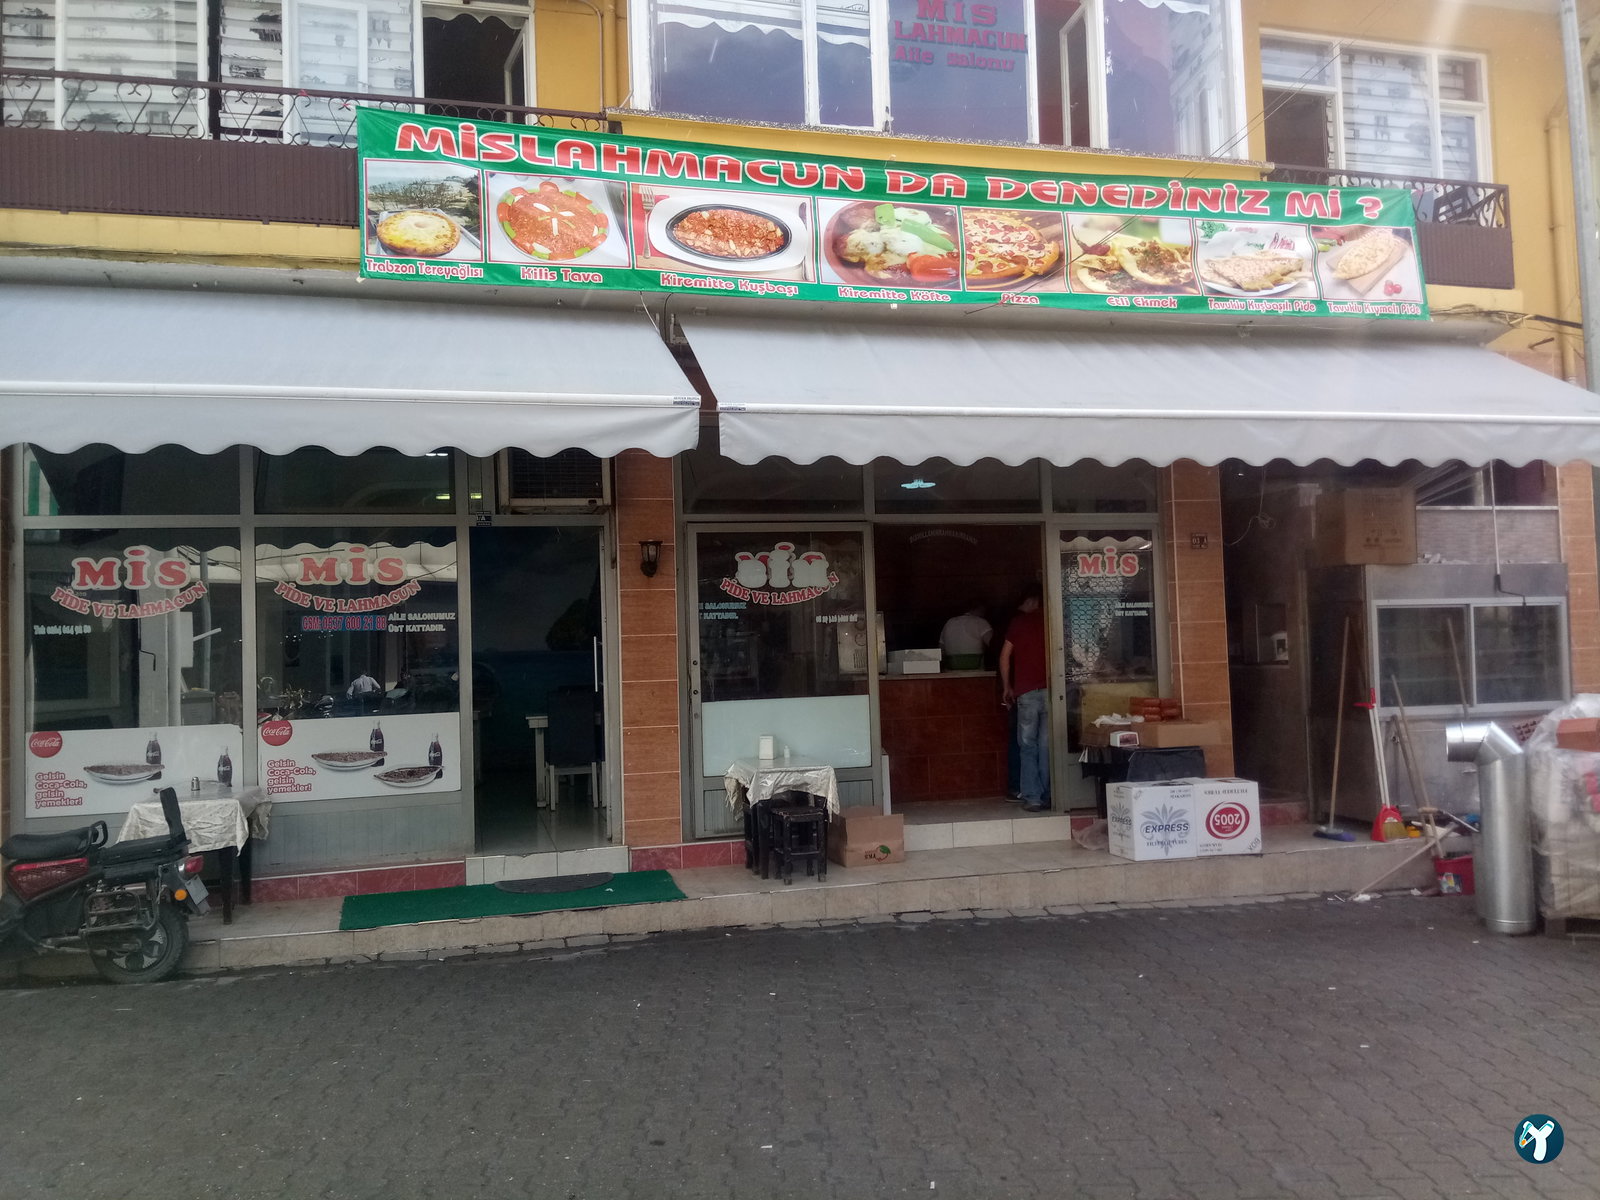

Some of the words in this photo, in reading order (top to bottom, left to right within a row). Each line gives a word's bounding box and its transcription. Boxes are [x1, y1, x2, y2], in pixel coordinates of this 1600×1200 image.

[893, 20, 1029, 53] LAHMACUN
[886, 170, 967, 199] DA
[986, 176, 1271, 216] DENEDİNİZ
[1284, 188, 1342, 220] Mİ
[1356, 196, 1383, 219] ?
[366, 259, 415, 274] Trabzon
[418, 261, 484, 280] Tereyağlısı
[520, 267, 557, 281] Kilis
[561, 268, 603, 283] Tava
[660, 272, 734, 291] Kiremitte
[738, 279, 799, 297] Kuşbaşı
[837, 286, 906, 301] Kiremitte
[910, 289, 951, 302] Köfte
[1000, 293, 1040, 305] Pizza
[1106, 296, 1130, 306] Etli
[1133, 297, 1177, 308] Ekmek
[1208, 299, 1246, 311] Tavuklu
[1247, 300, 1292, 314] Kuşbaşılı
[1294, 301, 1316, 312] Pide
[1327, 302, 1363, 313] Tavuklu
[1364, 303, 1400, 316] Kıymalı
[1401, 304, 1421, 315] Pide
[72, 546, 190, 589] MİS
[297, 545, 407, 584] MİS
[1078, 546, 1138, 577] MİS
[51, 587, 90, 615] PİDE
[92, 602, 116, 618] VE
[117, 581, 208, 619] LAHMACUN
[274, 580, 312, 608] PİDE
[313, 596, 335, 613] VE
[336, 579, 421, 613] LAHMACUN
[752, 592, 770, 604] VE
[267, 759, 296, 769] Gelsin
[35, 771, 66, 781] Gelsin
[267, 767, 316, 778] Coca-Cola,
[35, 780, 88, 791] Coca-Cola,
[267, 776, 296, 787] gelsin
[35, 788, 64, 800] gelsin
[267, 784, 312, 795] yemekler!
[35, 797, 83, 809] yemekler!
[1214, 813, 1241, 826] 2005
[1145, 822, 1189, 834] EXPRESS
